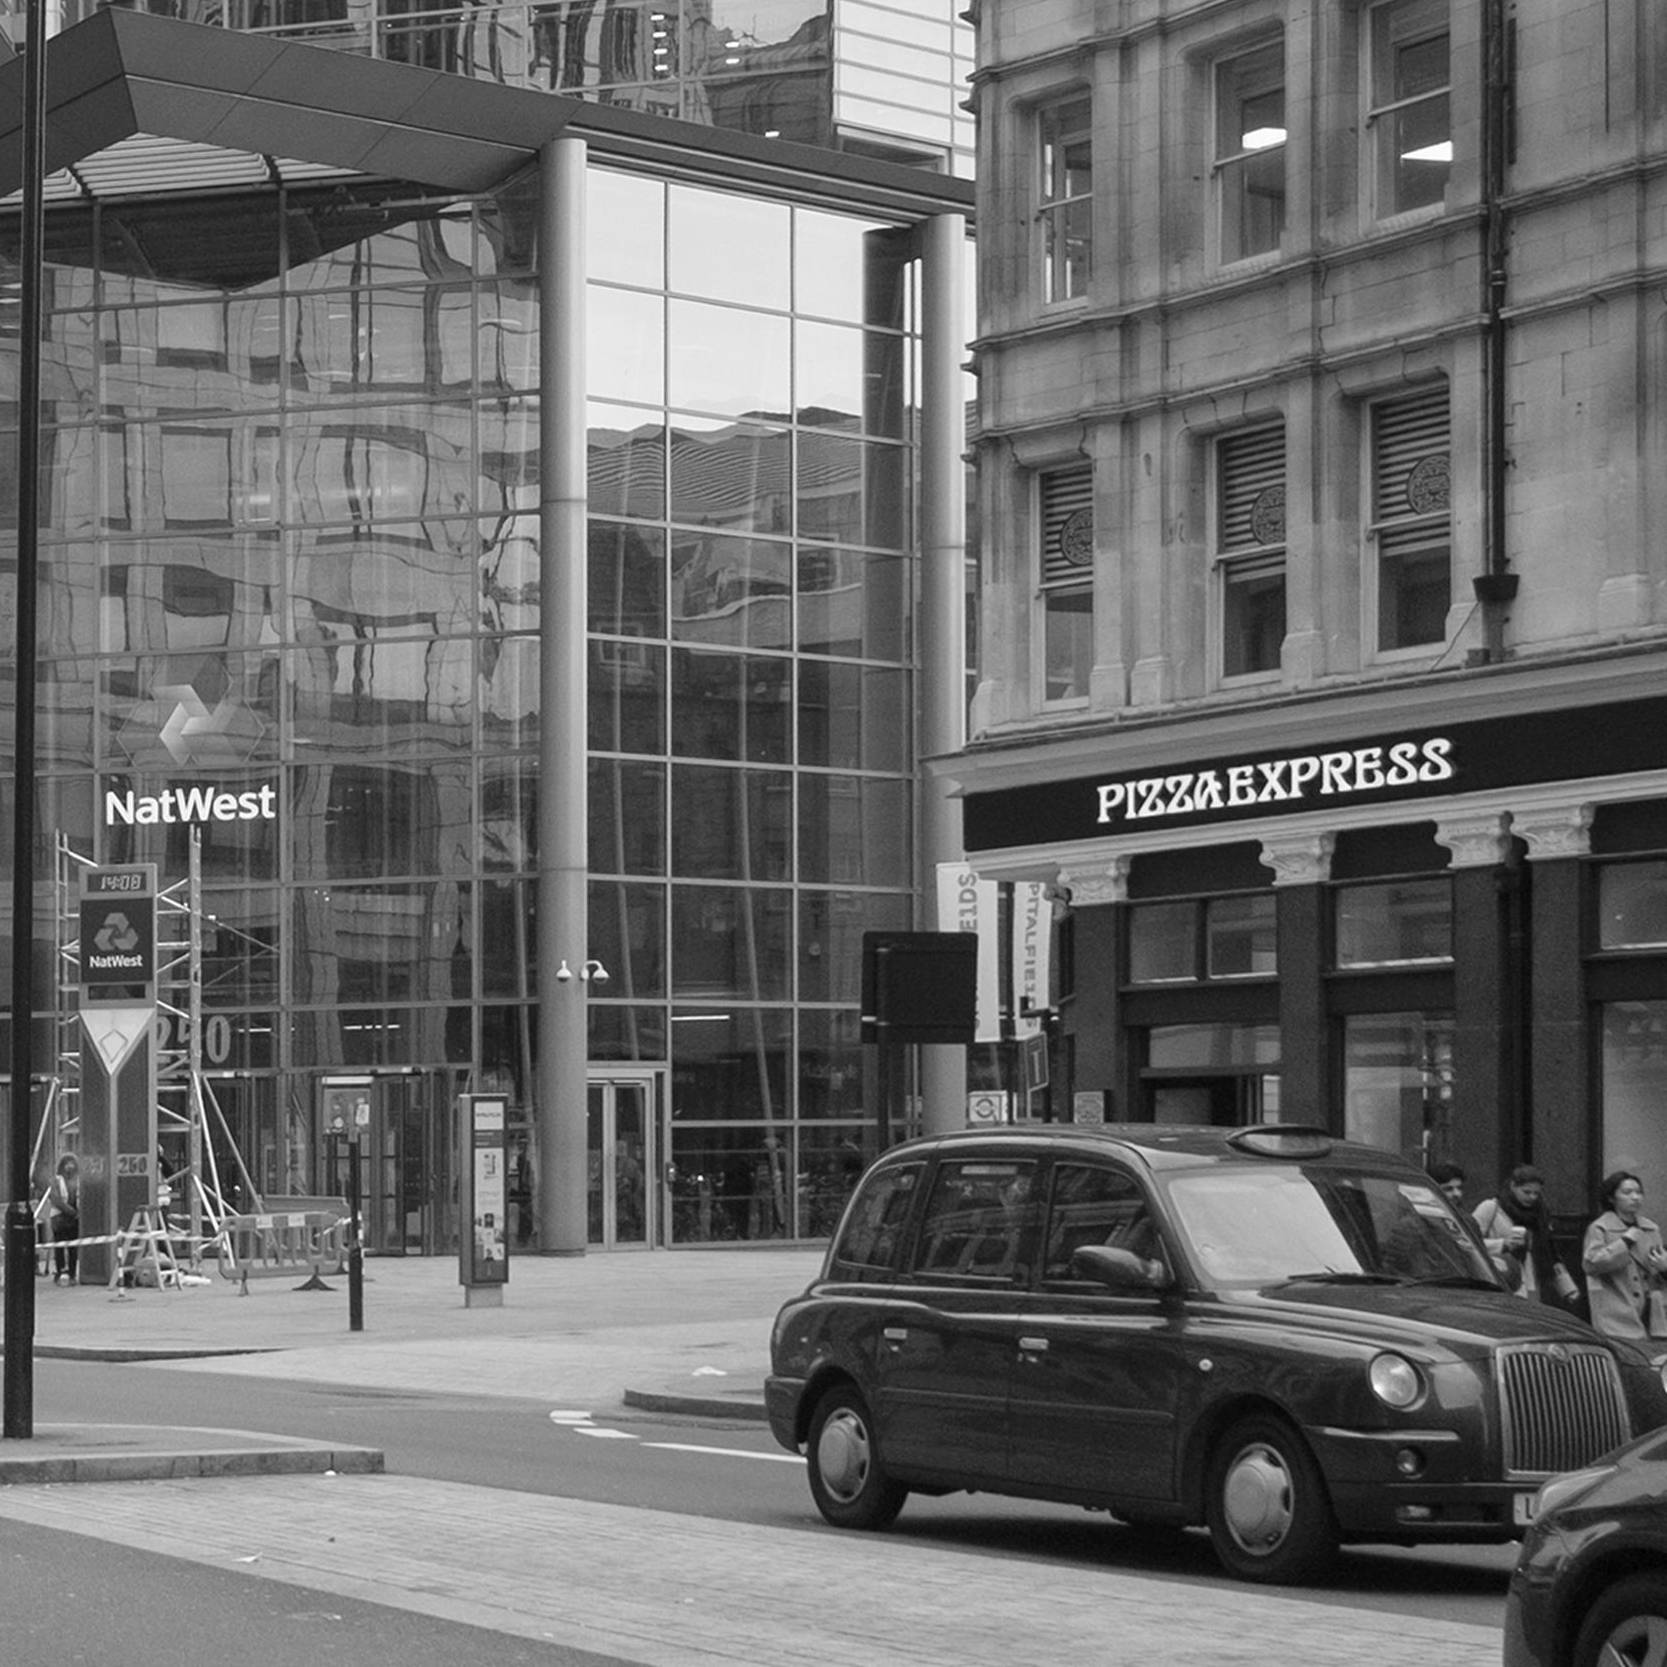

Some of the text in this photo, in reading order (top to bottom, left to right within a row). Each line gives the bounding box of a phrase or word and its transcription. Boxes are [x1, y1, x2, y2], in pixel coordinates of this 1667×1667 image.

[1096, 738, 1453, 823] PIZZAEXPRESS
[106, 784, 276, 825] NatWest
[89, 954, 143, 968] NatWest
